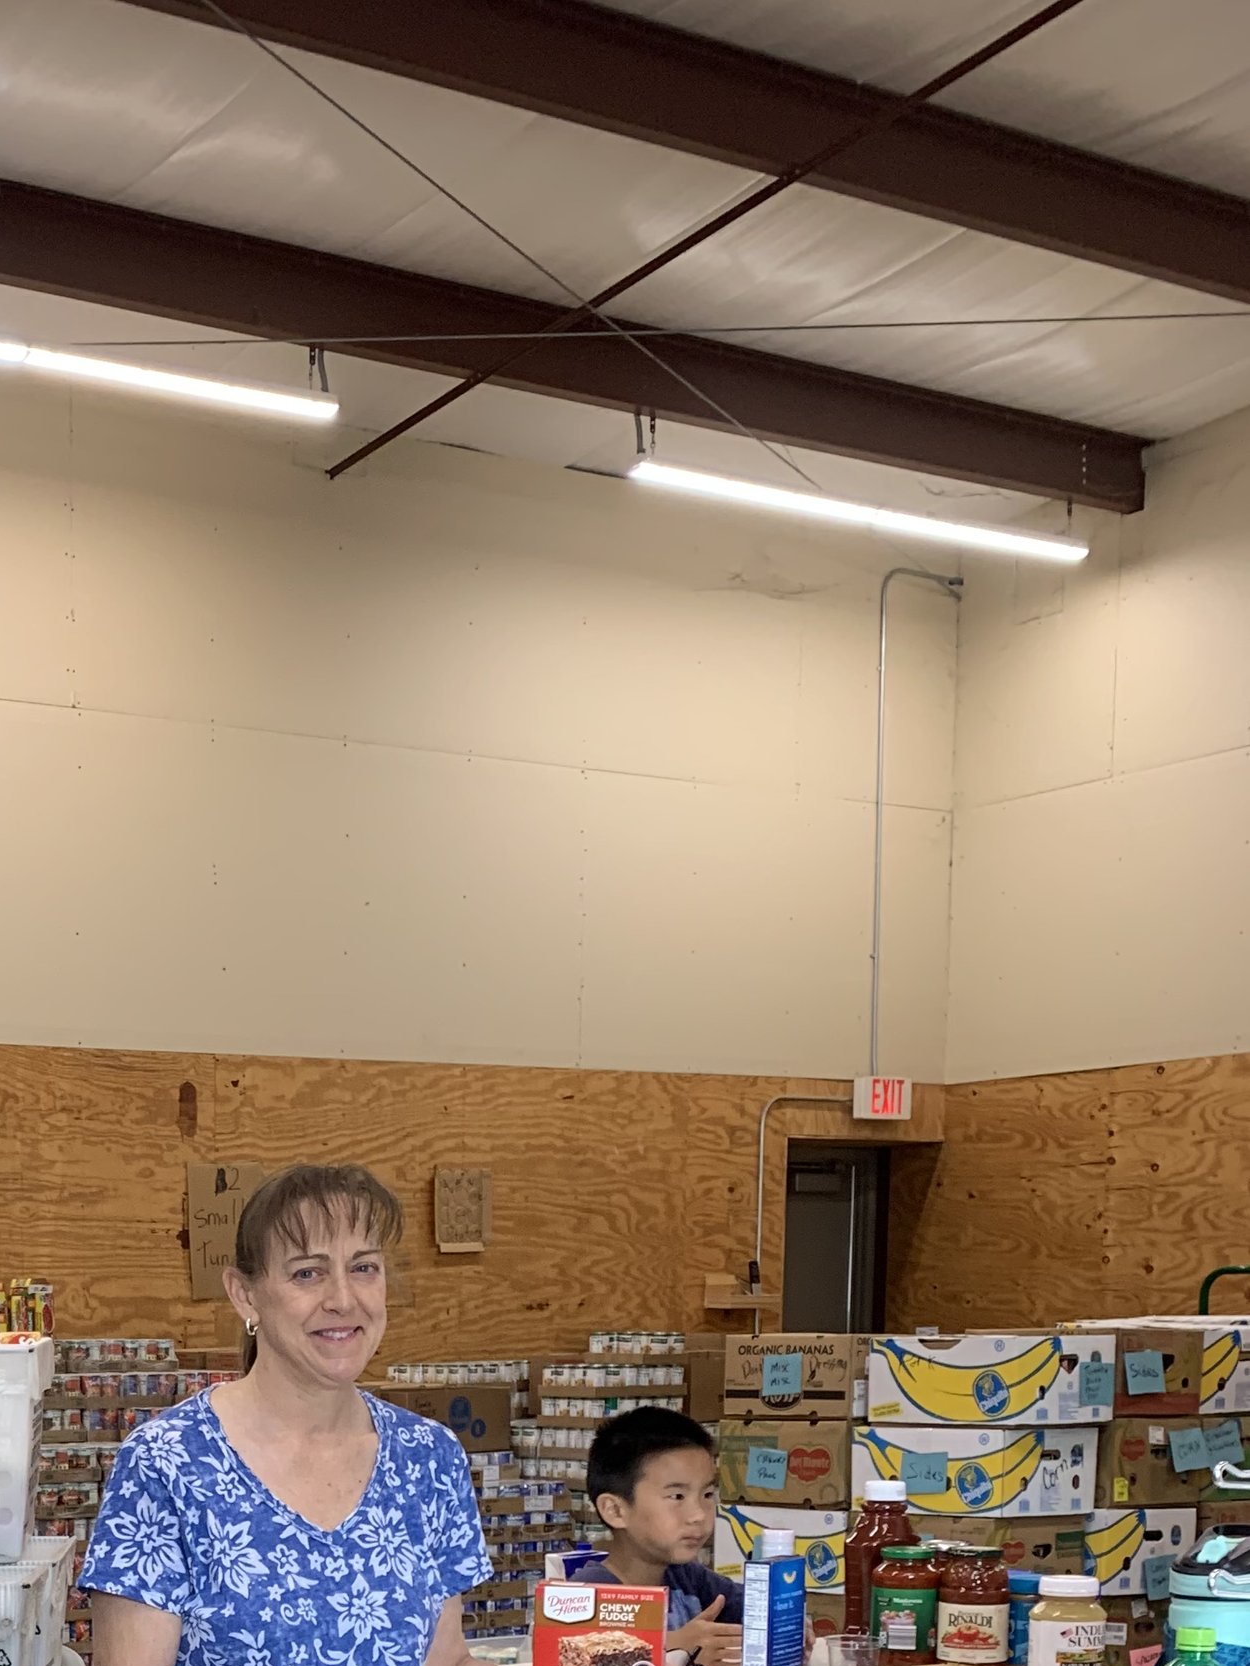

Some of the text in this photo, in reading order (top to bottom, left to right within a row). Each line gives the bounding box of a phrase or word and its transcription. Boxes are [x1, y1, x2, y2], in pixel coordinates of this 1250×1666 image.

[871, 1078, 905, 1115] EXIT
[197, 1240, 229, 1269] Tun
[738, 1344, 834, 1355] ORGANIC BANANAS
[548, 1595, 590, 1607] Duncan
[553, 1604, 588, 1616] Hines
[599, 1603, 641, 1613] CHEWY
[599, 1612, 635, 1622] FUDGE
